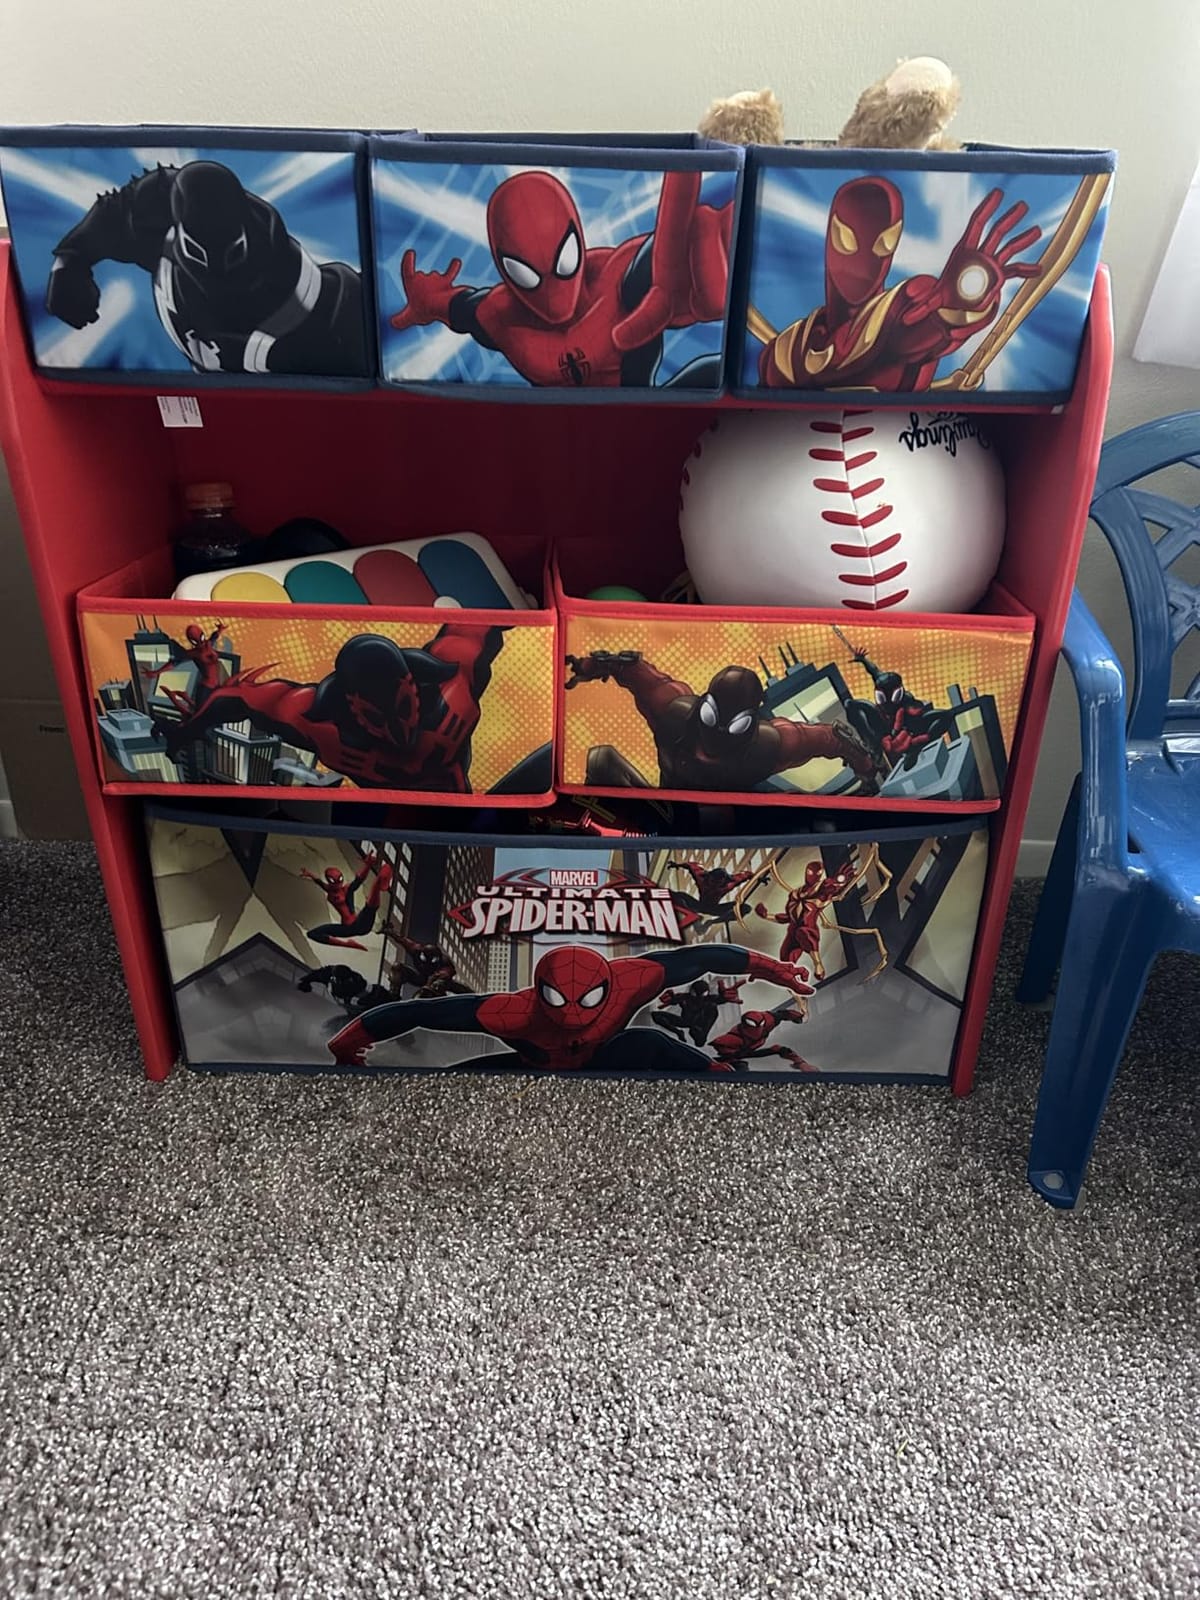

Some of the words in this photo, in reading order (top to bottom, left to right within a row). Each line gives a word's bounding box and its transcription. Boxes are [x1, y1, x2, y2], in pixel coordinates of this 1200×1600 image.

[551, 870, 598, 886] MARVEL
[476, 886, 671, 898] ULTIMATE
[462, 898, 682, 941] SPIDER-MAN
